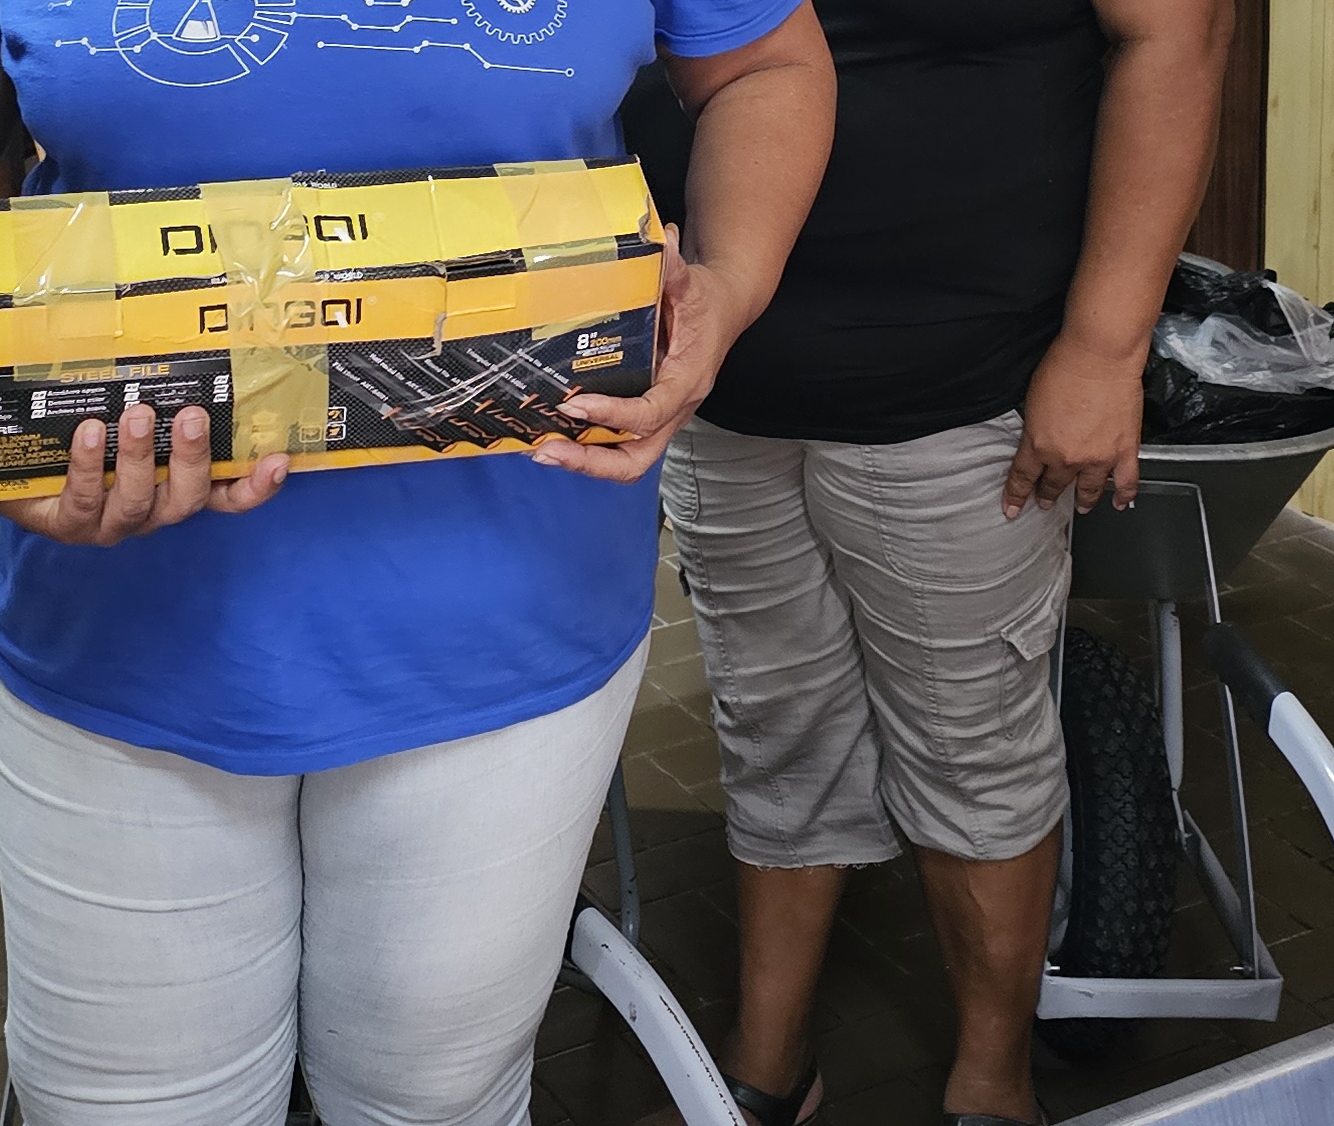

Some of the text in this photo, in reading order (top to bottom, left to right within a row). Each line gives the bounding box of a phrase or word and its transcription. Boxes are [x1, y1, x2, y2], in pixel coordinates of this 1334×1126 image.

[575, 354, 619, 366] UNIVERSAL
[60, 363, 171, 384] STEEL FILE
[31, 438, 61, 446] STEEL
